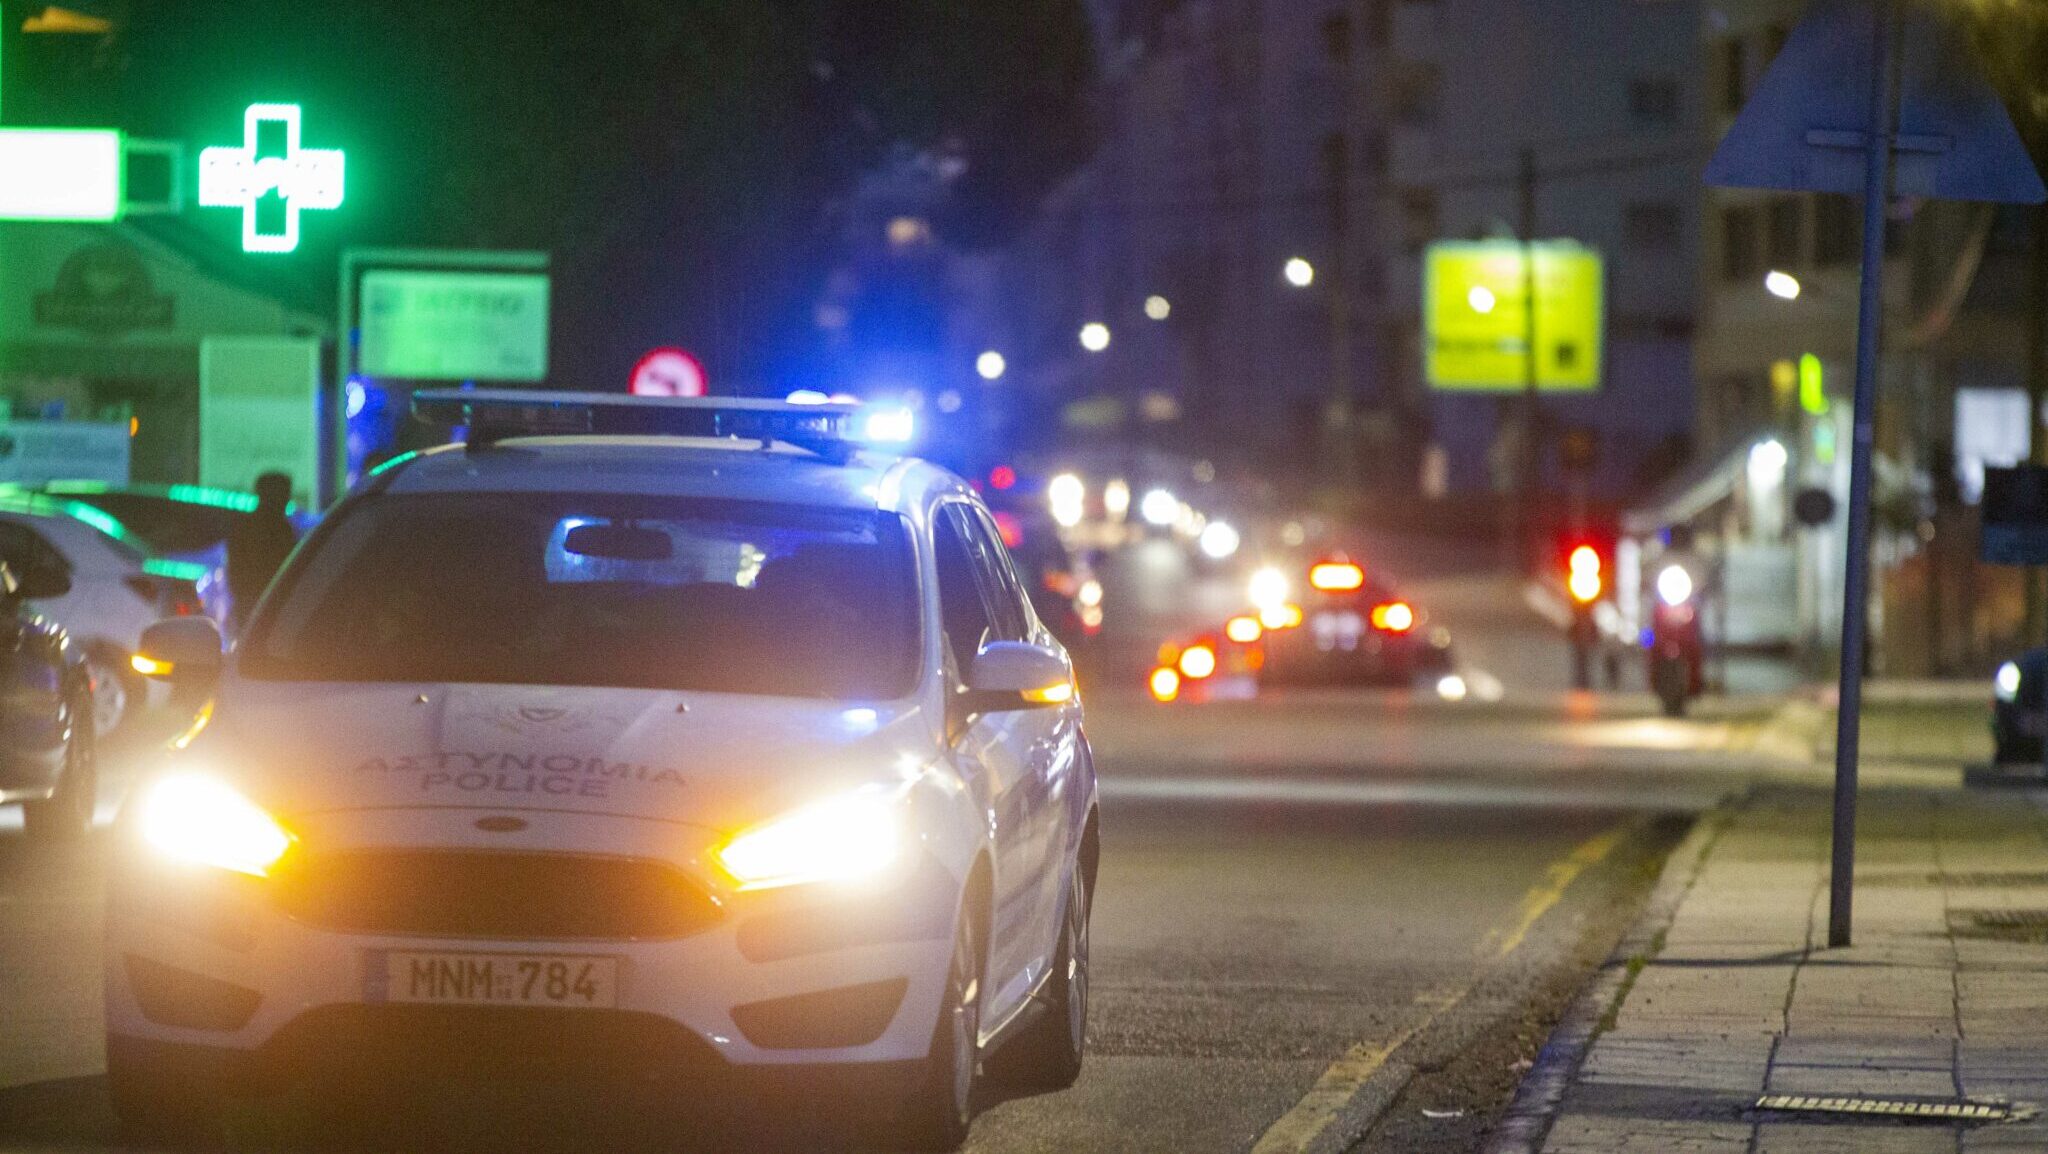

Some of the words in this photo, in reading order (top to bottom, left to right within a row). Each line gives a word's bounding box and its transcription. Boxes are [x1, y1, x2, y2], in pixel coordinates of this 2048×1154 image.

[420, 771, 611, 799] POLICE
[409, 959, 493, 998] MNM
[517, 961, 598, 1001] 784
